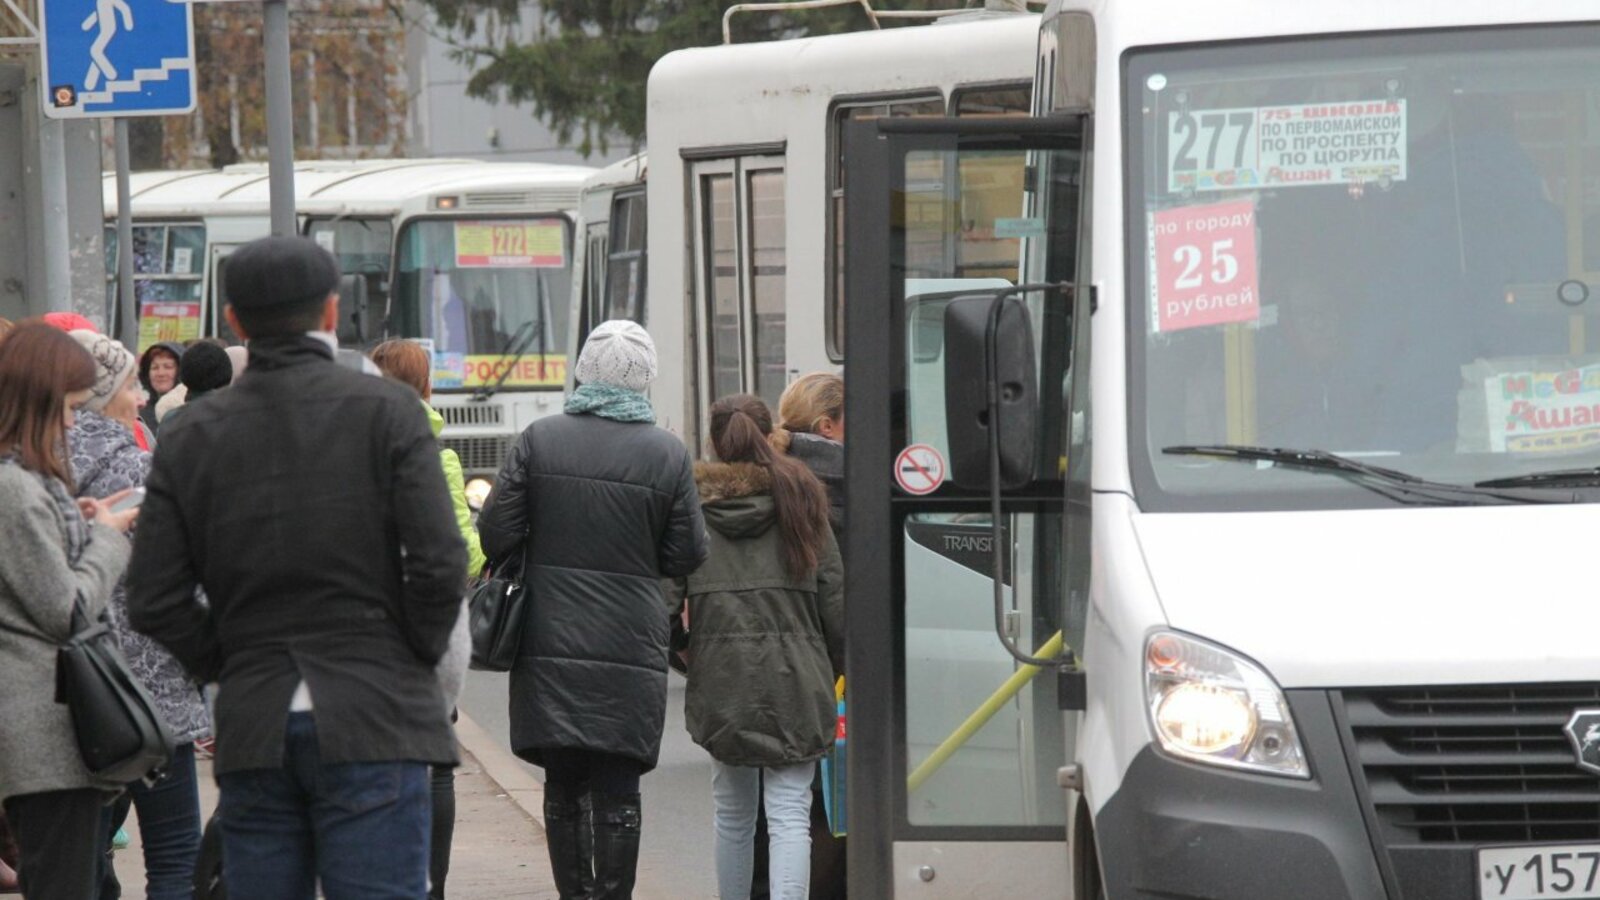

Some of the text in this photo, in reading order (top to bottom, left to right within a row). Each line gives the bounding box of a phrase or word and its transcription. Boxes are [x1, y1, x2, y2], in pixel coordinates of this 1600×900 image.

[1261, 122, 1281, 137] ПО
[1172, 112, 1254, 170] 277
[1261, 131, 1400, 152] ПО ПРОСПЕКТУ
[1280, 147, 1400, 166] ПО ЦЮРУПА
[1186, 211, 1253, 232] городу
[495, 226, 524, 255] 272
[1173, 238, 1238, 291] 25
[1166, 286, 1253, 318] рублей
[942, 535, 994, 552] TRANSI
